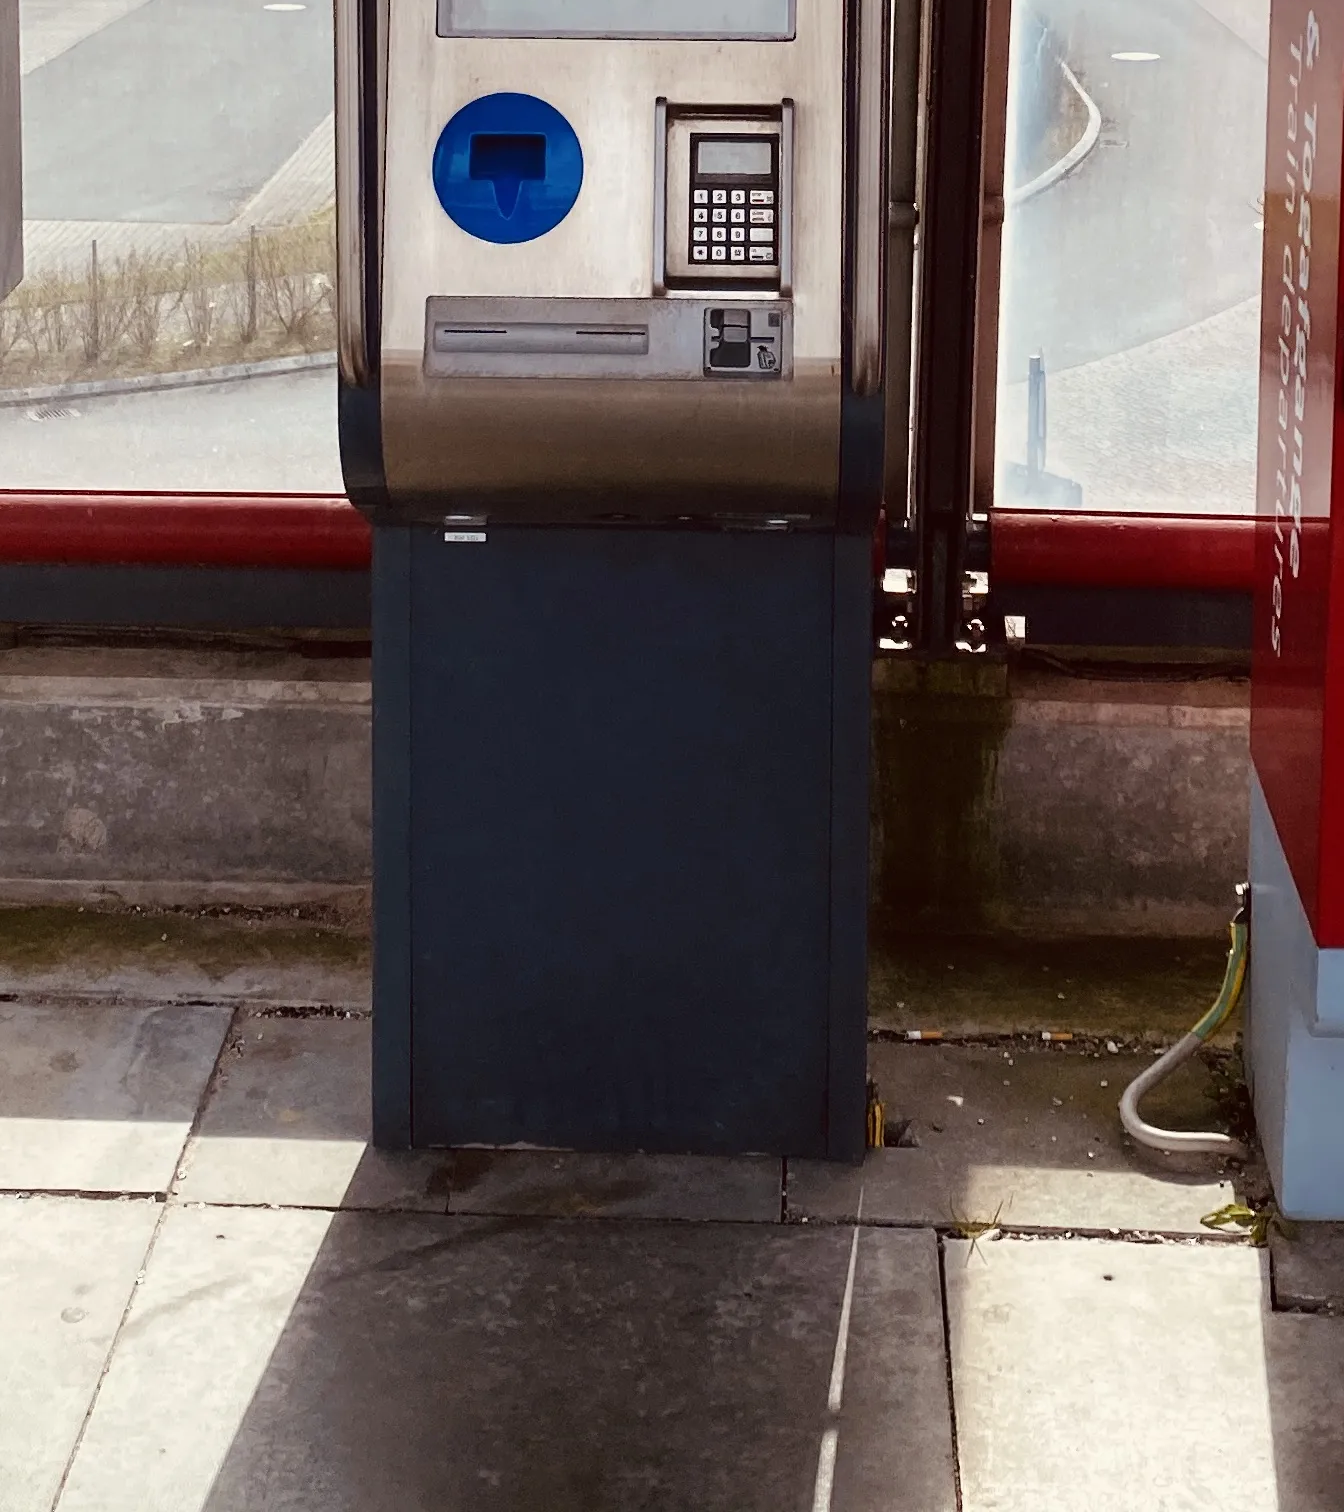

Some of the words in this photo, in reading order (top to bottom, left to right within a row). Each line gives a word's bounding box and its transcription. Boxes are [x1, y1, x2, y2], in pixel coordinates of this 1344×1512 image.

[1284, 35, 1304, 214] Train
[1305, 8, 1321, 72] &
[1270, 243, 1296, 658] departures
[1287, 101, 1320, 579] Togafgange
